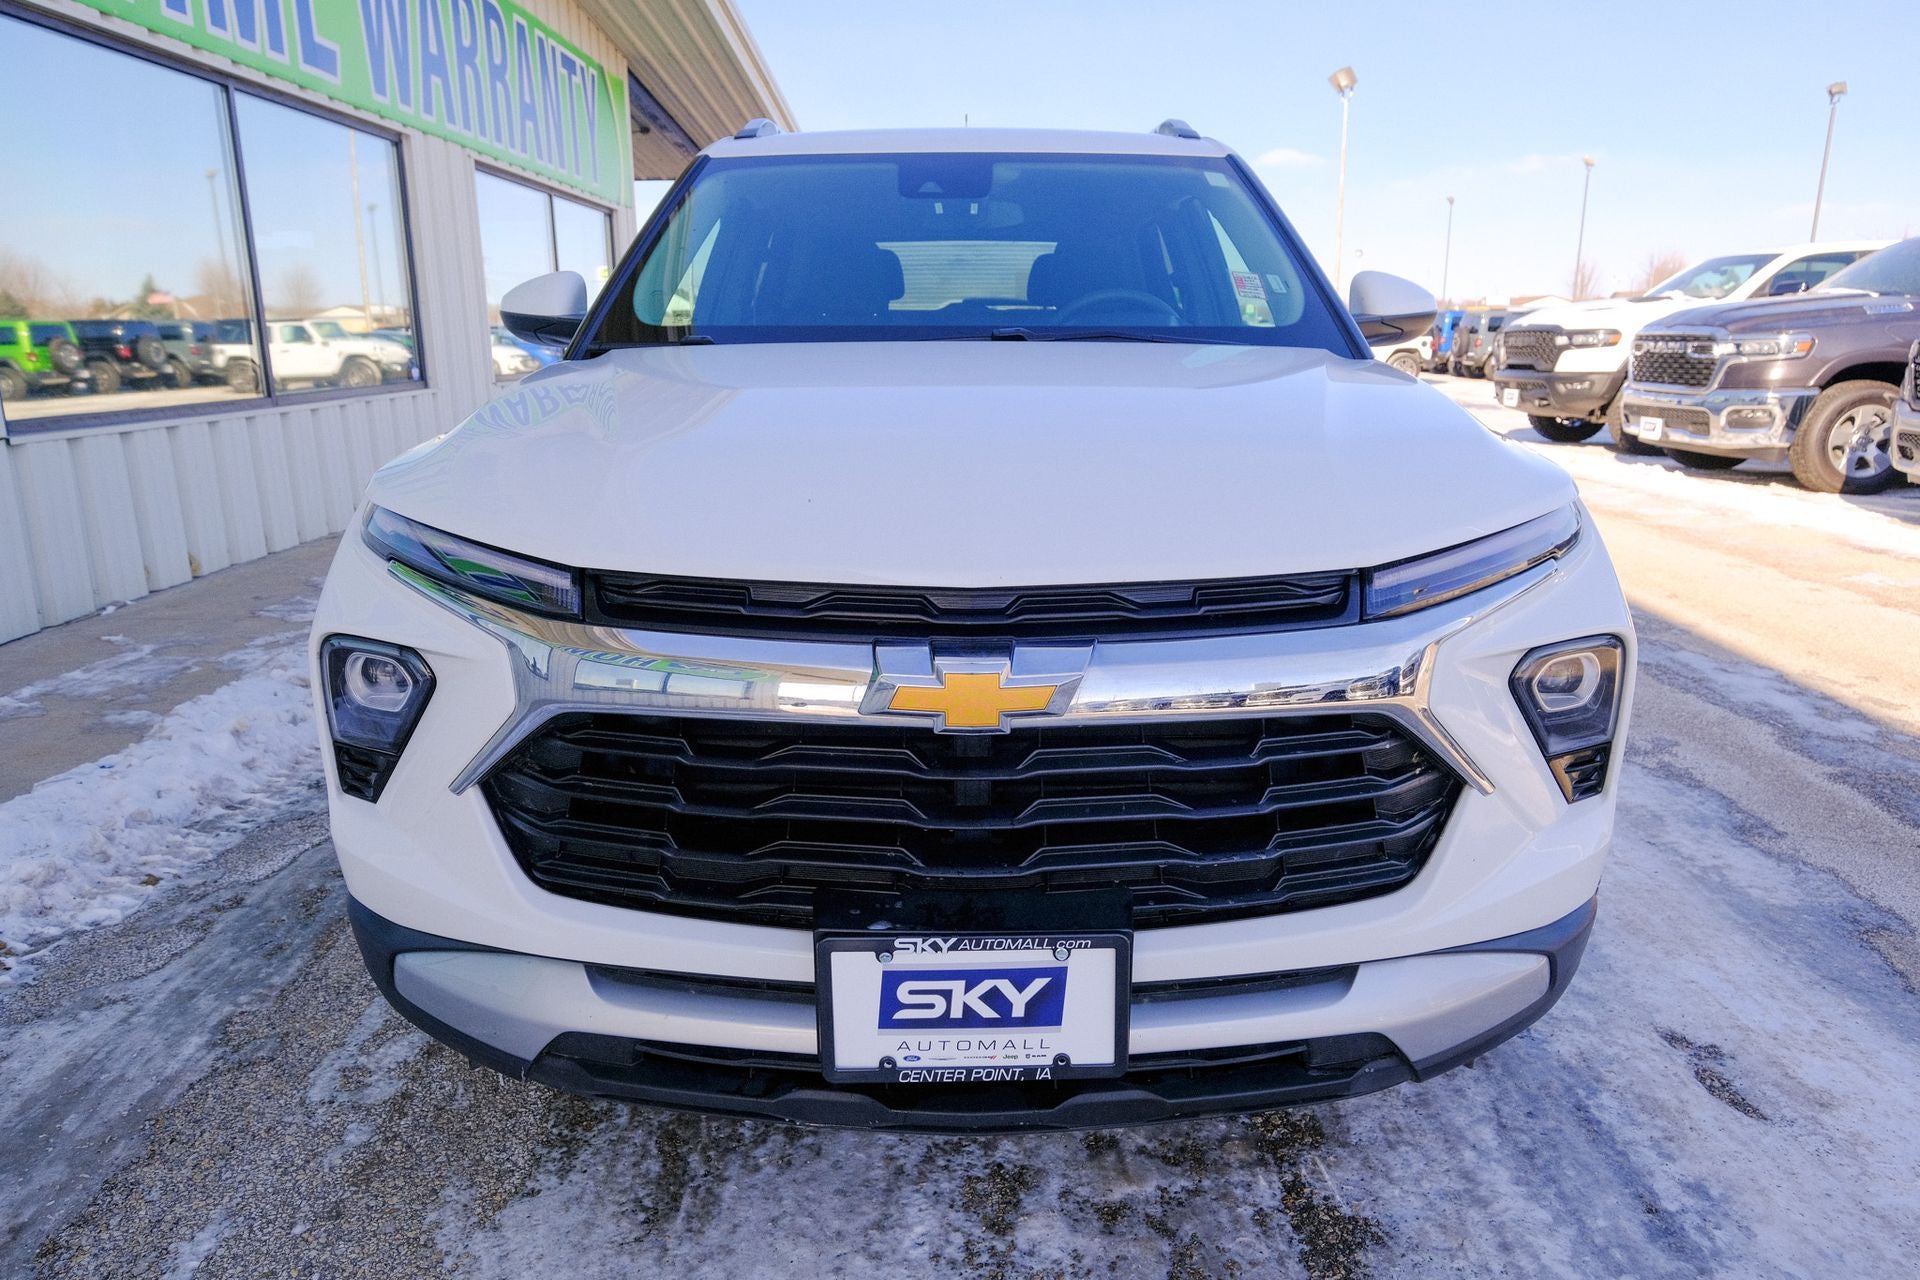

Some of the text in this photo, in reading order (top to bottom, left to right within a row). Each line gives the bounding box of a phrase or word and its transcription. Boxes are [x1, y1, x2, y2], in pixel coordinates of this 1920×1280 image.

[357, 0, 600, 186] WARRANTY
[893, 937, 958, 954] SKY
[892, 977, 1053, 1020] SKY
[896, 1038, 1051, 1052] AUTOMALL
[899, 1067, 1052, 1083] CENTER POINT, IA
